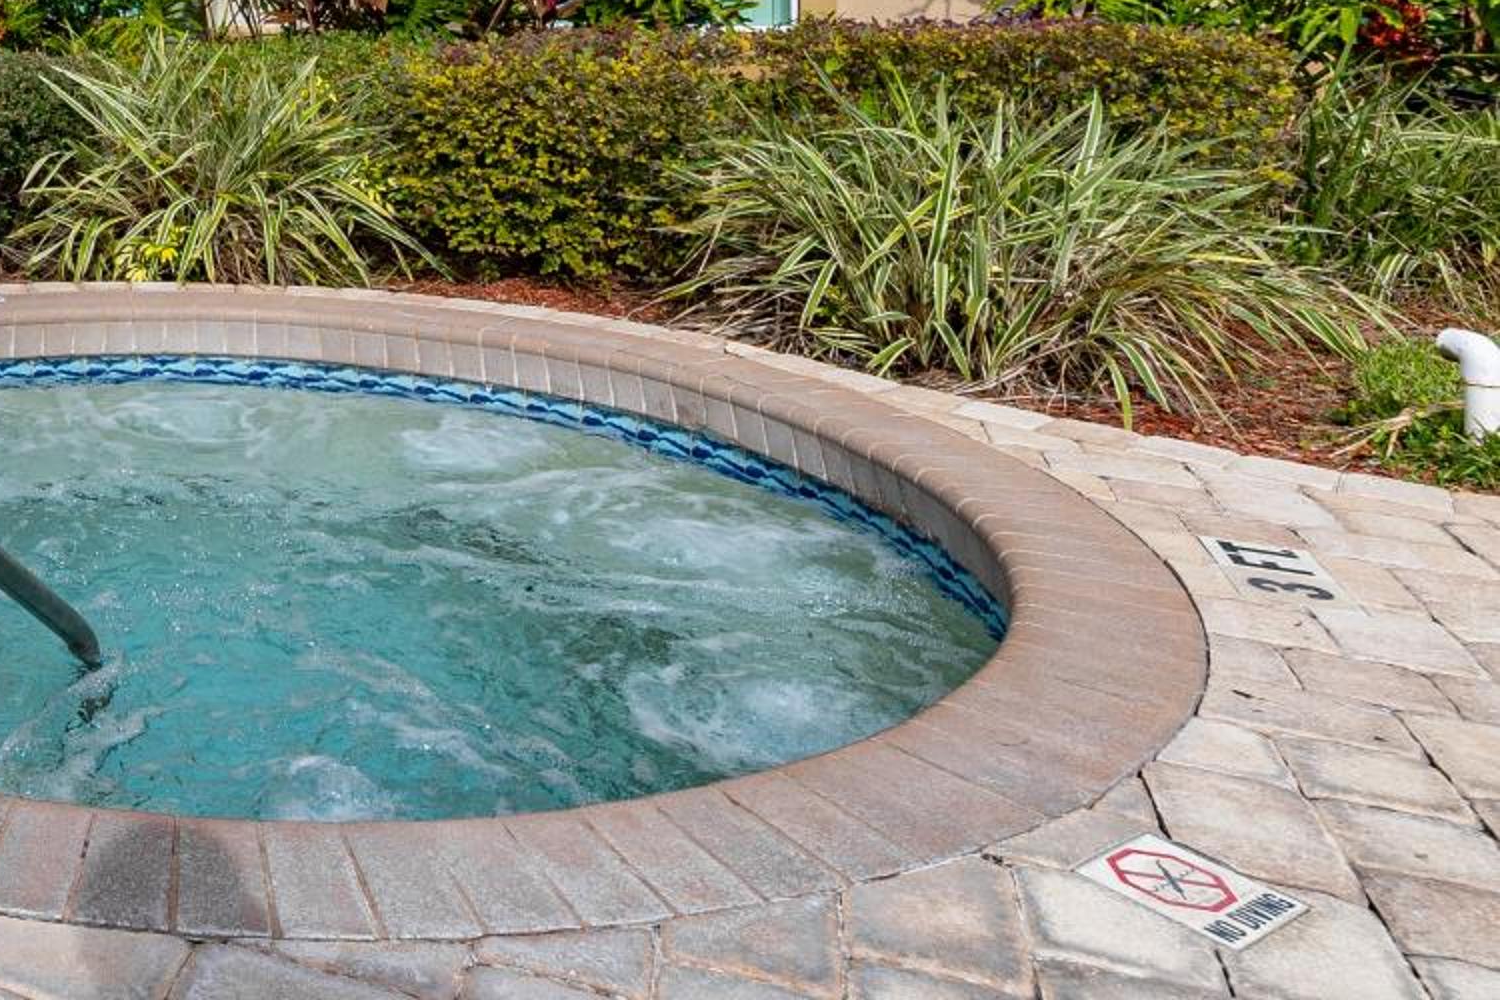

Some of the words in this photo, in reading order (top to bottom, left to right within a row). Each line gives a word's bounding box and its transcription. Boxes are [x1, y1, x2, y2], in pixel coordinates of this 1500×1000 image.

[1216, 539, 1316, 577] FT
[1247, 577, 1335, 601] 3
[1203, 919, 1247, 943] NO
[1226, 893, 1296, 930] DIVING
